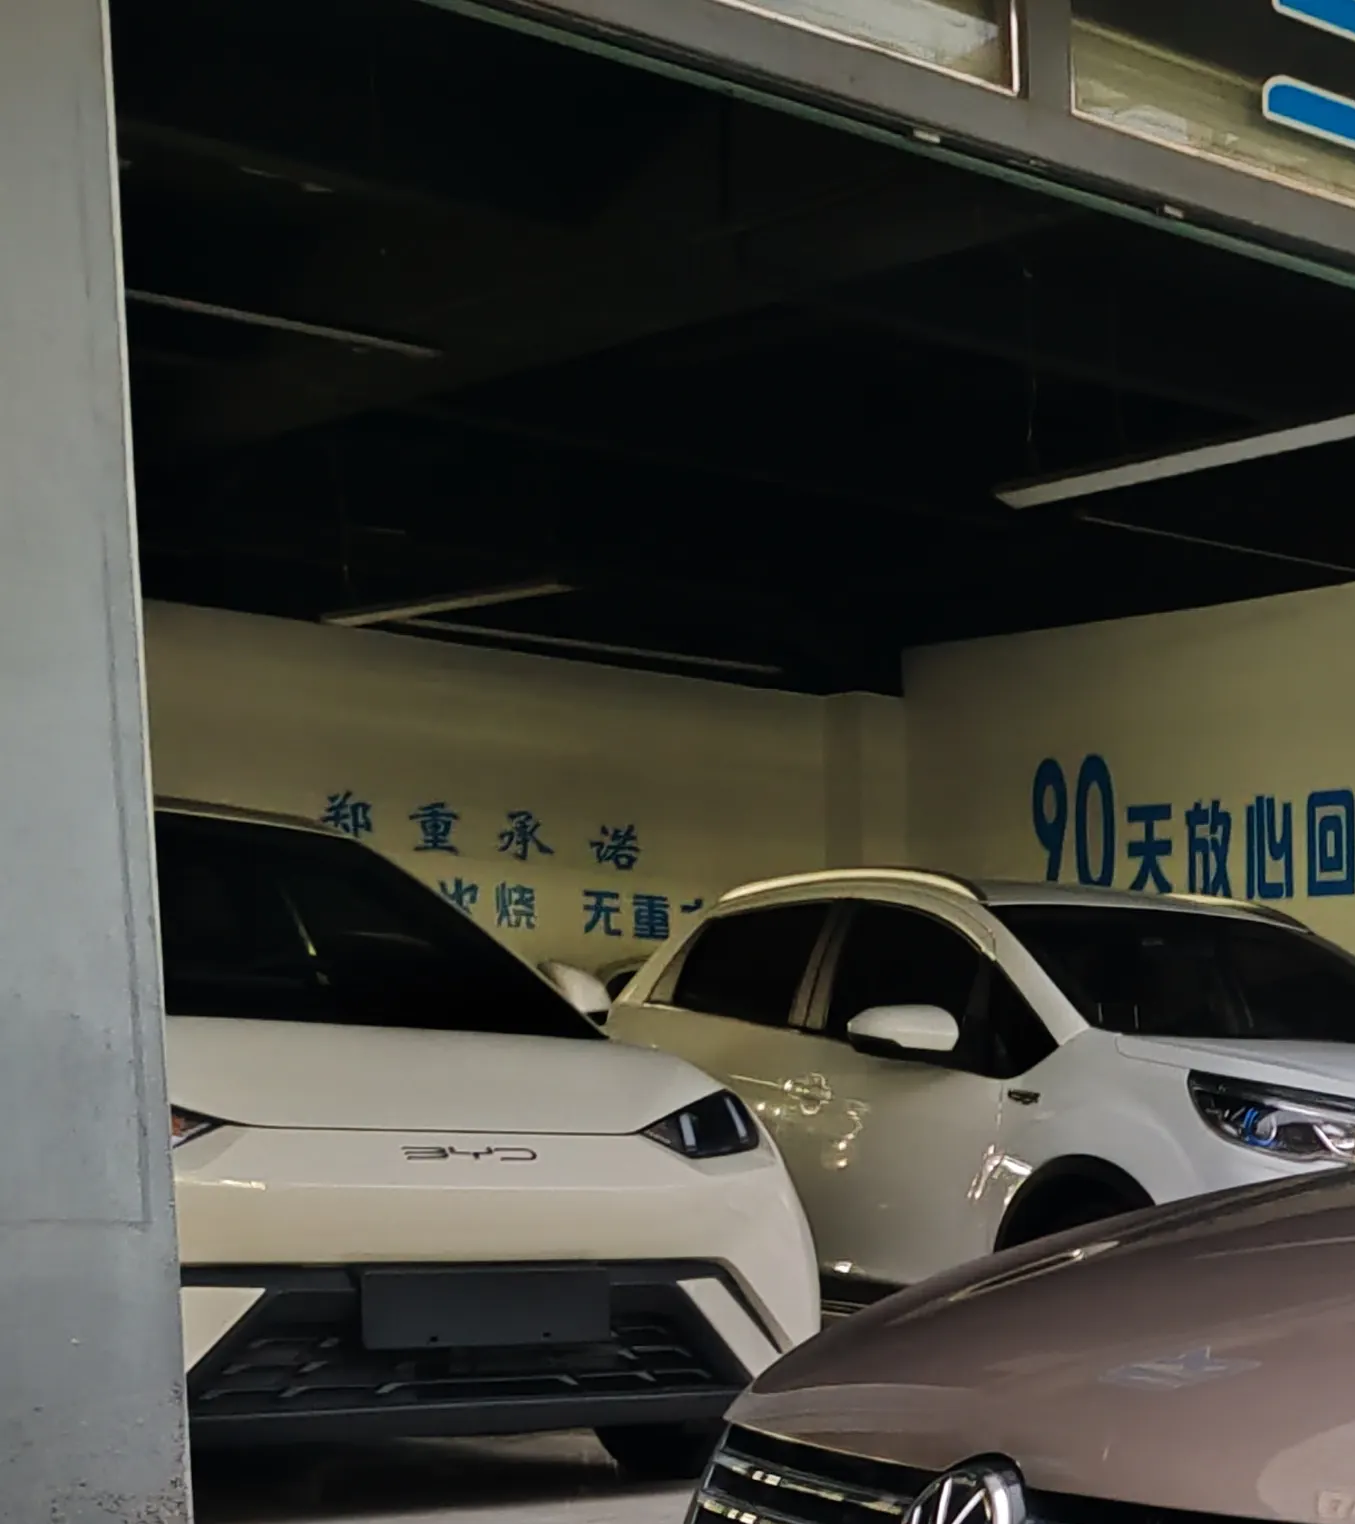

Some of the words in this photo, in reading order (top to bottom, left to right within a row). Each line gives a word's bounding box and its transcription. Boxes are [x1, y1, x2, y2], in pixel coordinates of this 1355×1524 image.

[320, 790, 642, 870] 郑重承诺
[583, 888, 703, 940] 无重
[401, 1146, 537, 1162] BYD
